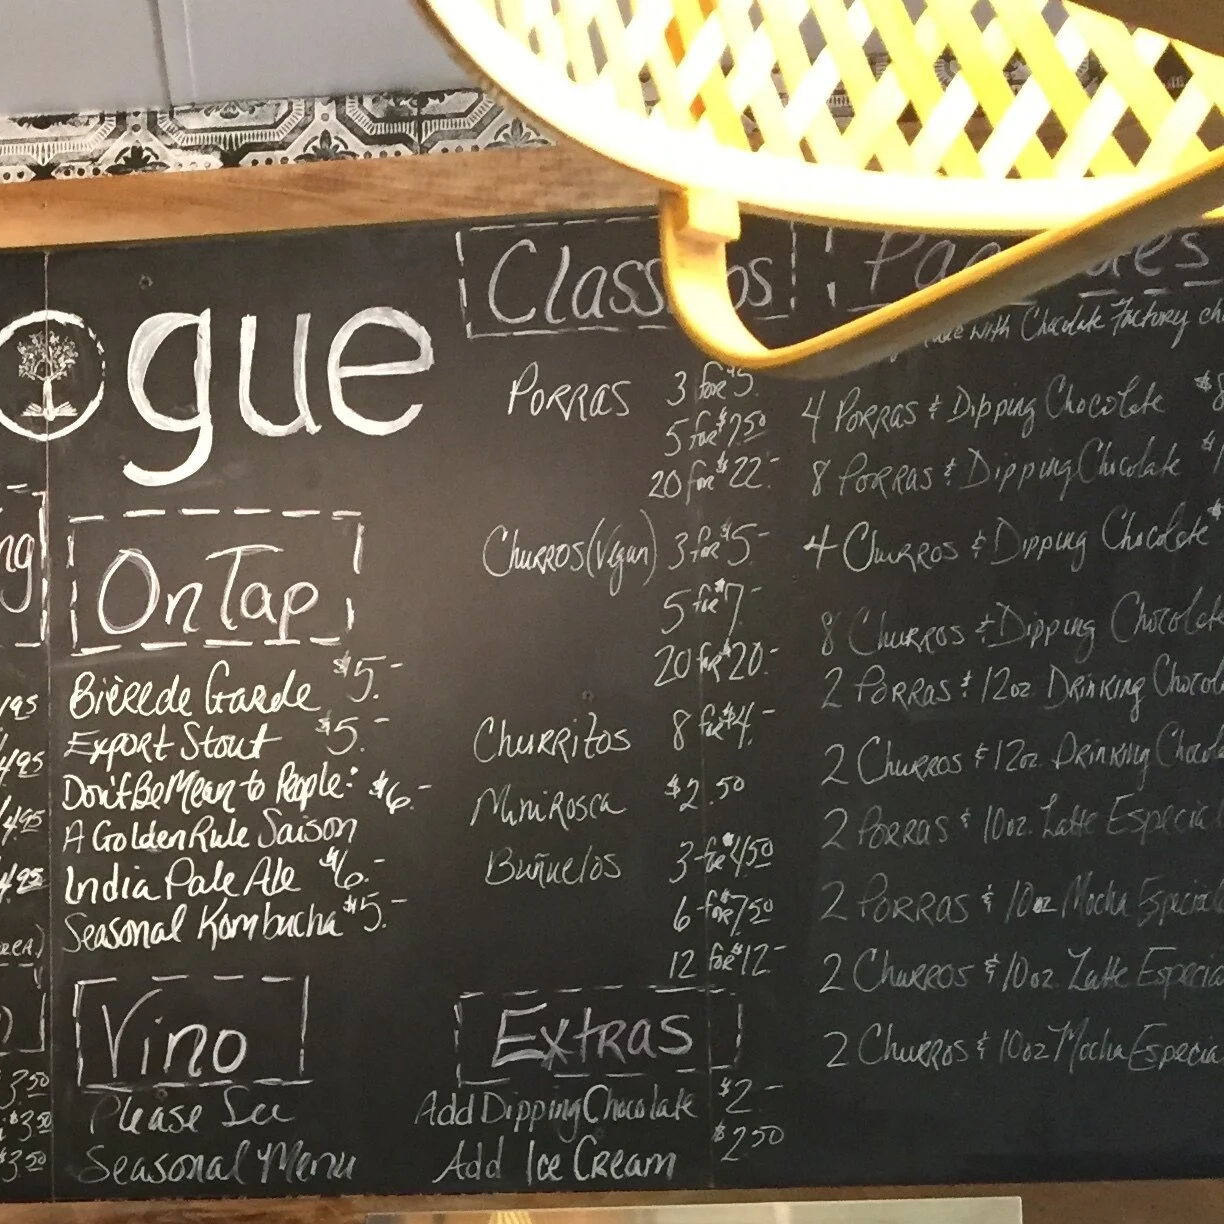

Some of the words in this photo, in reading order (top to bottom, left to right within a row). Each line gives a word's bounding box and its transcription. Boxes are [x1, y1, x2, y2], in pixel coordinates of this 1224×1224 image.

[488, 238, 774, 325] Classos
[947, 385, 1035, 438] Dipping
[1046, 374, 1165, 419] Chocolate
[648, 470, 681, 498] 20
[960, 448, 1074, 501] Dipping
[842, 521, 959, 573] Churros
[991, 517, 1087, 572] Dipping
[206, 544, 320, 645] Tap
[848, 606, 966, 656] Churros
[988, 602, 1097, 664] Dipping
[205, 660, 321, 716] Garde
[654, 645, 692, 687] 20
[1044, 664, 1147, 722] Drinking
[63, 724, 175, 772] Export
[180, 721, 283, 760] Stout
[474, 712, 631, 764] Churritos
[857, 736, 962, 785] Churros
[1051, 732, 1150, 791] Drinking
[239, 769, 265, 802] to
[92, 816, 186, 852] Golden
[189, 815, 250, 852] Rule
[258, 807, 358, 848] Saison
[1042, 793, 1099, 839] Latte
[65, 862, 162, 904] India
[165, 856, 241, 900] Pale
[244, 856, 302, 896] Ale
[484, 845, 622, 889] Buñuelos
[63, 903, 188, 952] Seasonal
[198, 899, 343, 951] Kombucha
[669, 950, 698, 979] 12
[853, 948, 975, 993] Churros
[1067, 947, 1128, 991] Latte
[102, 988, 248, 1078] Vino
[492, 1002, 693, 1070] Extras
[858, 1023, 969, 1071] Churros
[90, 1095, 203, 1134] Please
[221, 1085, 295, 1128] See
[415, 1091, 475, 1126] Add
[77, 1140, 251, 1185] Seasonal
[257, 1139, 357, 1183] Menu
[432, 1135, 505, 1183] Add
[527, 1140, 564, 1185] Ice
[573, 1134, 676, 1181] Cream
